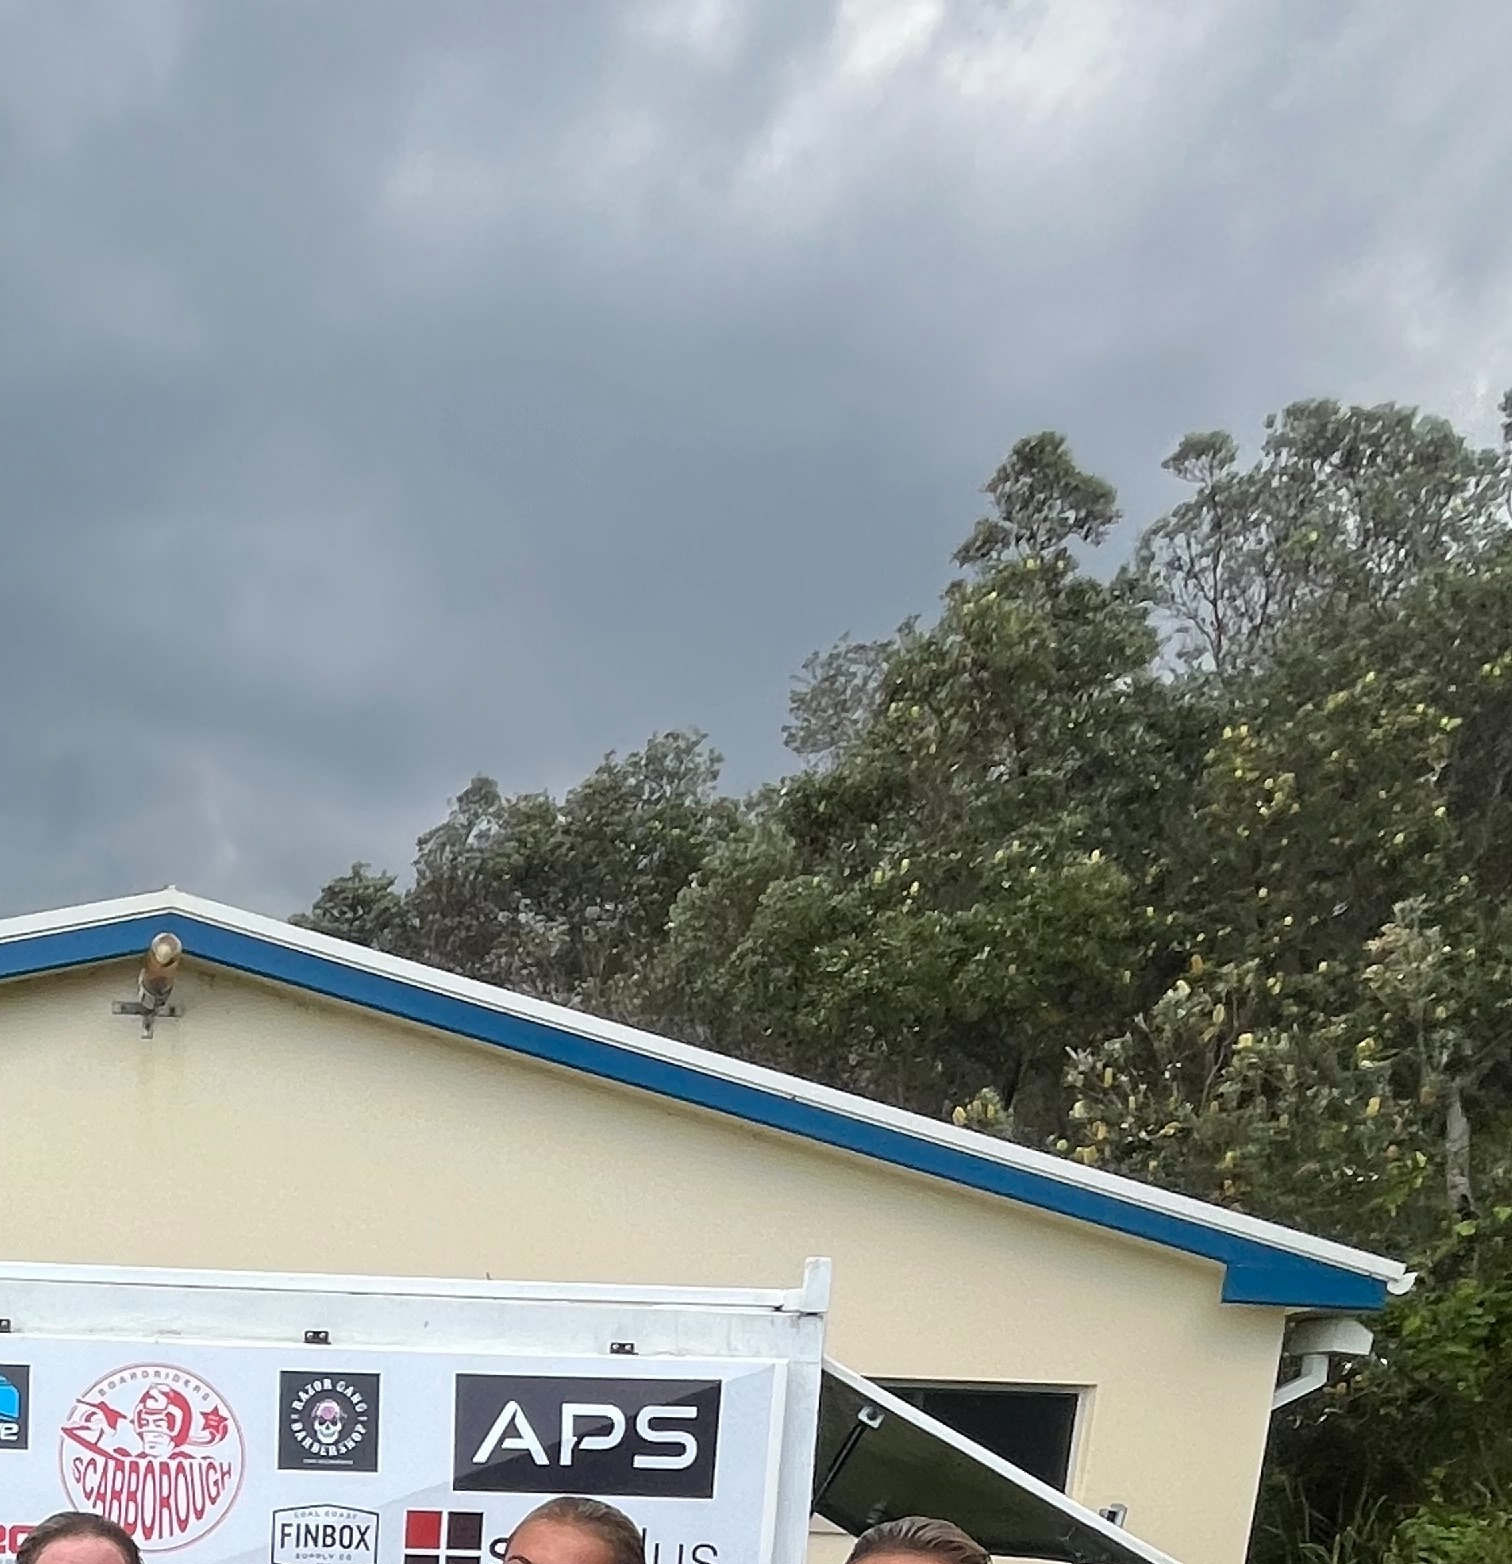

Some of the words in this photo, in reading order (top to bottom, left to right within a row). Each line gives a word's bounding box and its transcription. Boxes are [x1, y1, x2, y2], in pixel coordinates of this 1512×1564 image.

[97, 1370, 212, 1401] BOARDRIDERS
[291, 1379, 333, 1411] RAZOR
[336, 1381, 368, 1412] GANG
[290, 1422, 368, 1456] BARBERSHOP
[472, 1400, 699, 1470] APS
[72, 1456, 232, 1541] SCARBOROUGH
[280, 1522, 371, 1552] FINBOX
